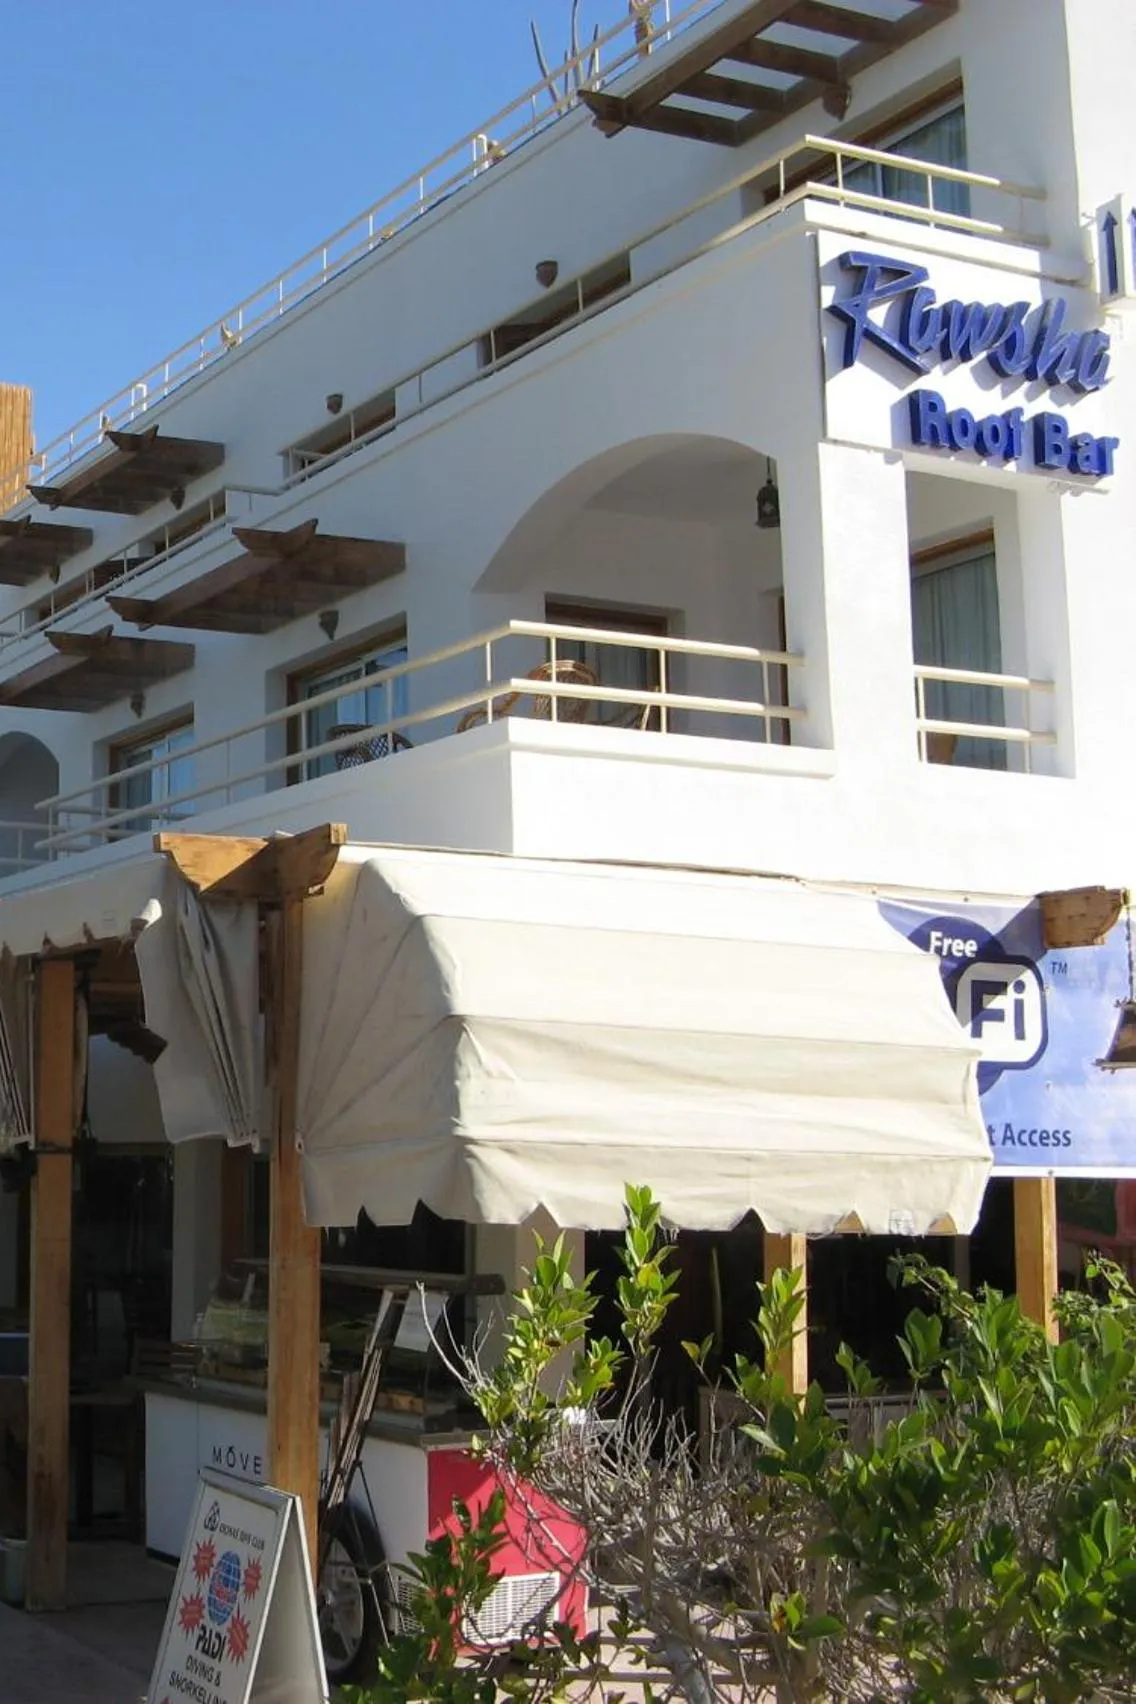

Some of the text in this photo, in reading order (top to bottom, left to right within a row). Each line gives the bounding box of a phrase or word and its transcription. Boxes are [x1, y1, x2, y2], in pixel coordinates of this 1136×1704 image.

[906, 388, 1120, 477] Roof Bar
[929, 930, 978, 958] Free
[1001, 1122, 1072, 1148] Access
[195, 1623, 227, 1663] PADI
[186, 1654, 214, 1683] DIVING
